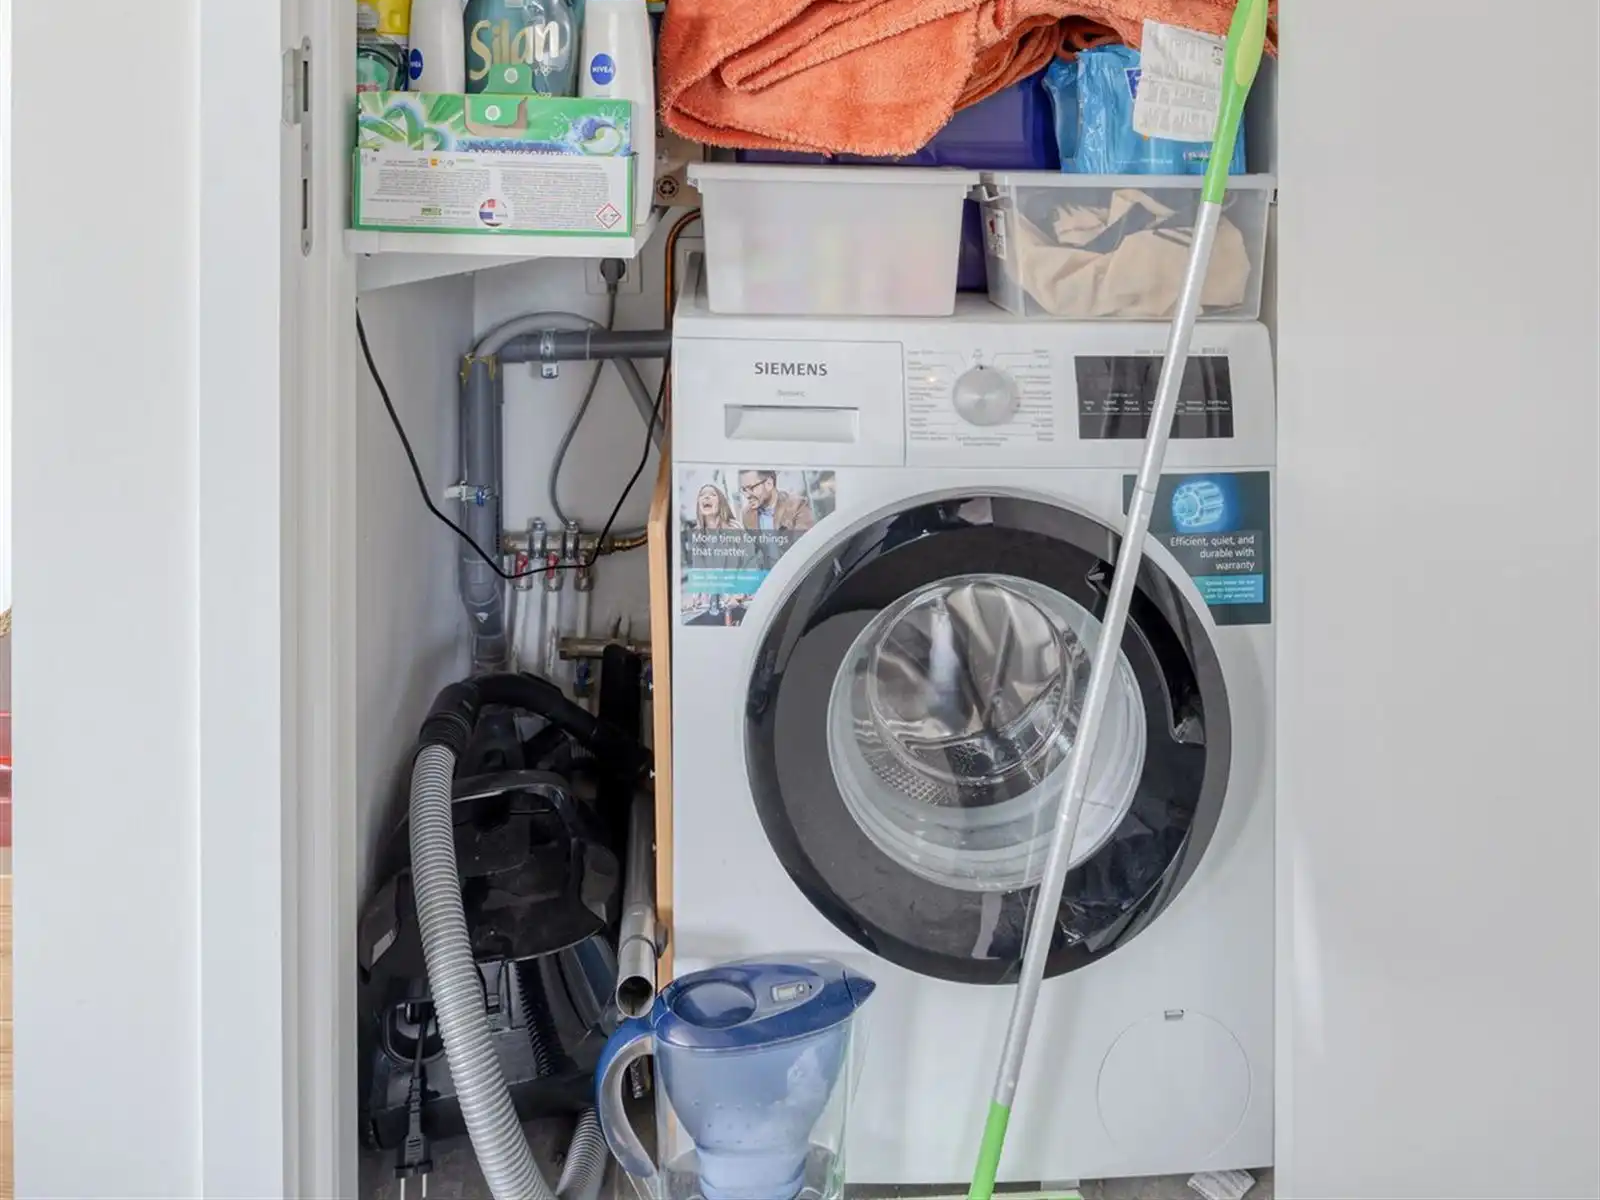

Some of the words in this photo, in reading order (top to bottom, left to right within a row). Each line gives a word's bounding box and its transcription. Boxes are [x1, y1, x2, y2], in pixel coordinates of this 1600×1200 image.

[469, 18, 560, 81] Silan
[592, 65, 614, 75] NIVEA
[754, 360, 828, 377] SIEMENS
[692, 533, 718, 544] More
[719, 533, 741, 544] time
[743, 532, 757, 544] for
[759, 532, 789, 546] things
[1170, 535, 1209, 547] Efficient,
[1211, 536, 1235, 546] quiet,
[1237, 534, 1255, 545] and
[692, 547, 712, 556] that
[713, 547, 749, 557] matter.
[1200, 548, 1233, 558] durable
[1235, 547, 1255, 557] with
[1215, 561, 1255, 572] warranty
